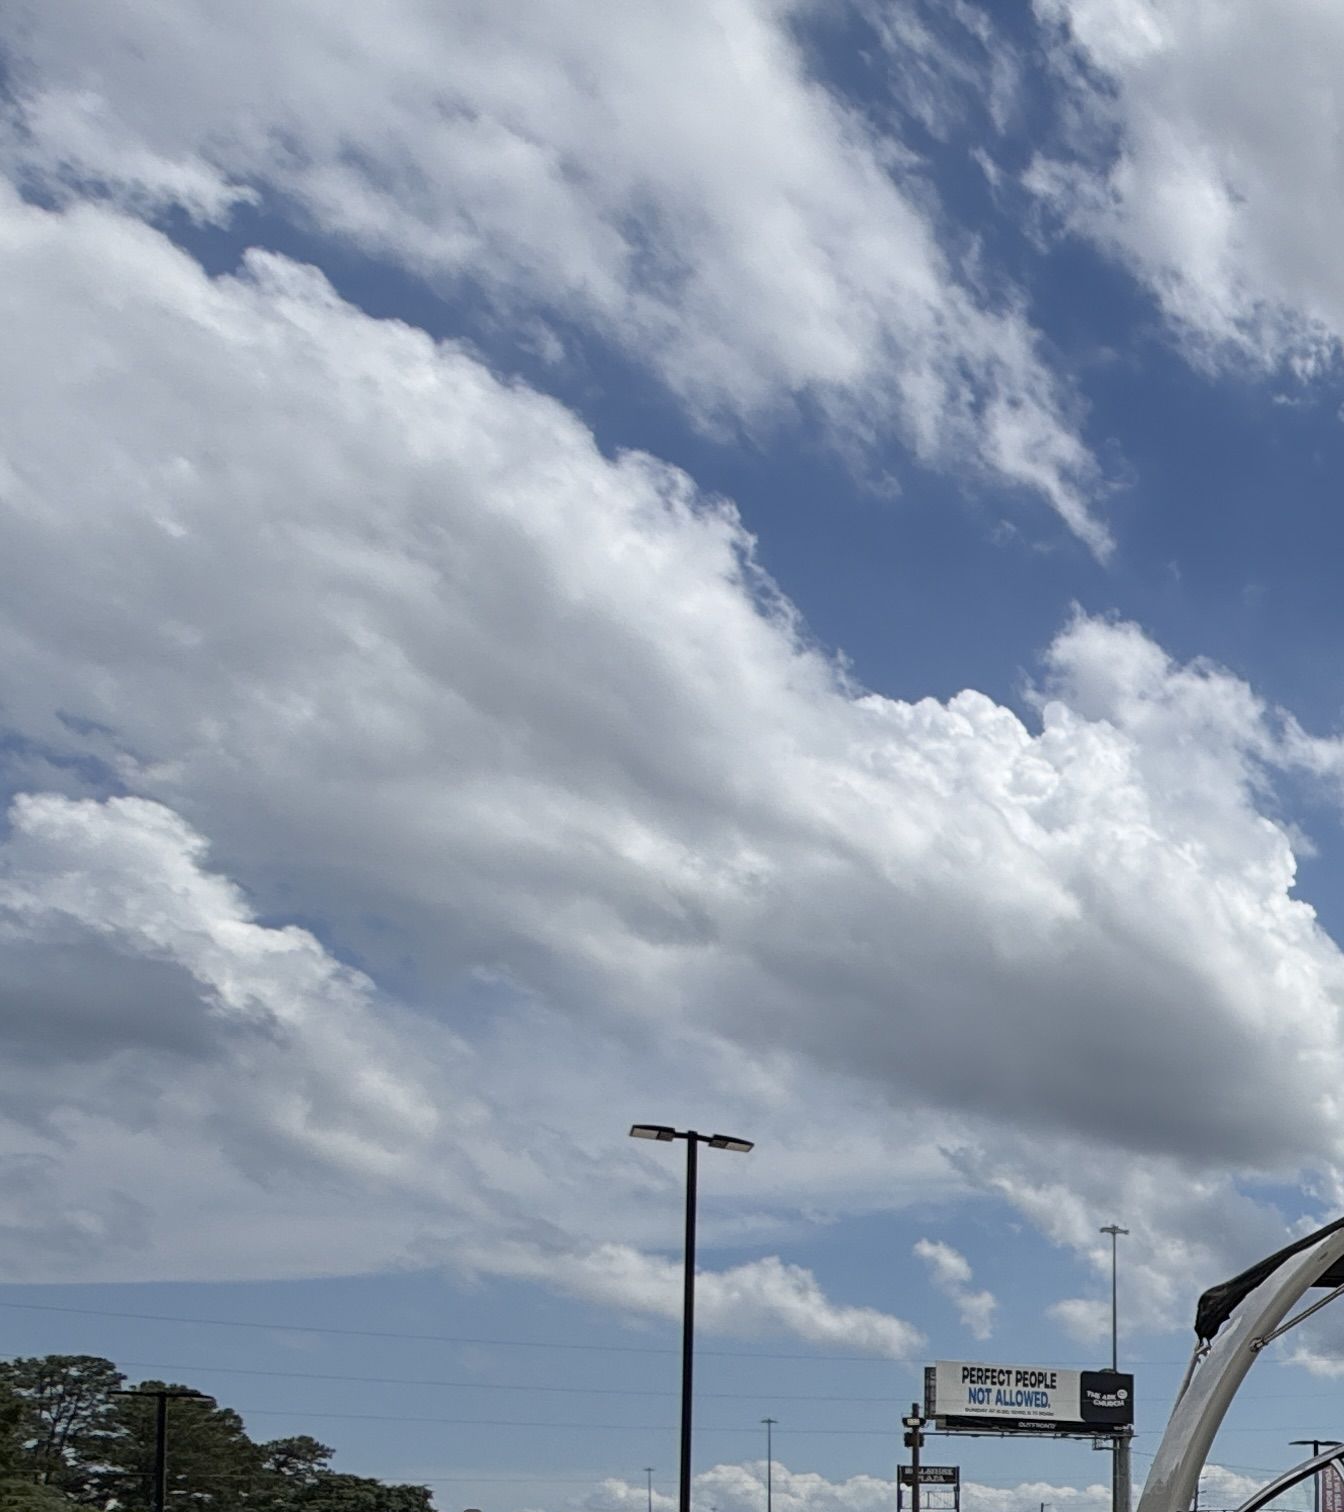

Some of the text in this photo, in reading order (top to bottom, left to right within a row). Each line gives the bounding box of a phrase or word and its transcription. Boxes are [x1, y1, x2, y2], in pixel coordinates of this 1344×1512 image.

[962, 1366, 1057, 1389] PERFECT PEOPLE
[968, 1387, 1051, 1409] NOT ALLOWED.
